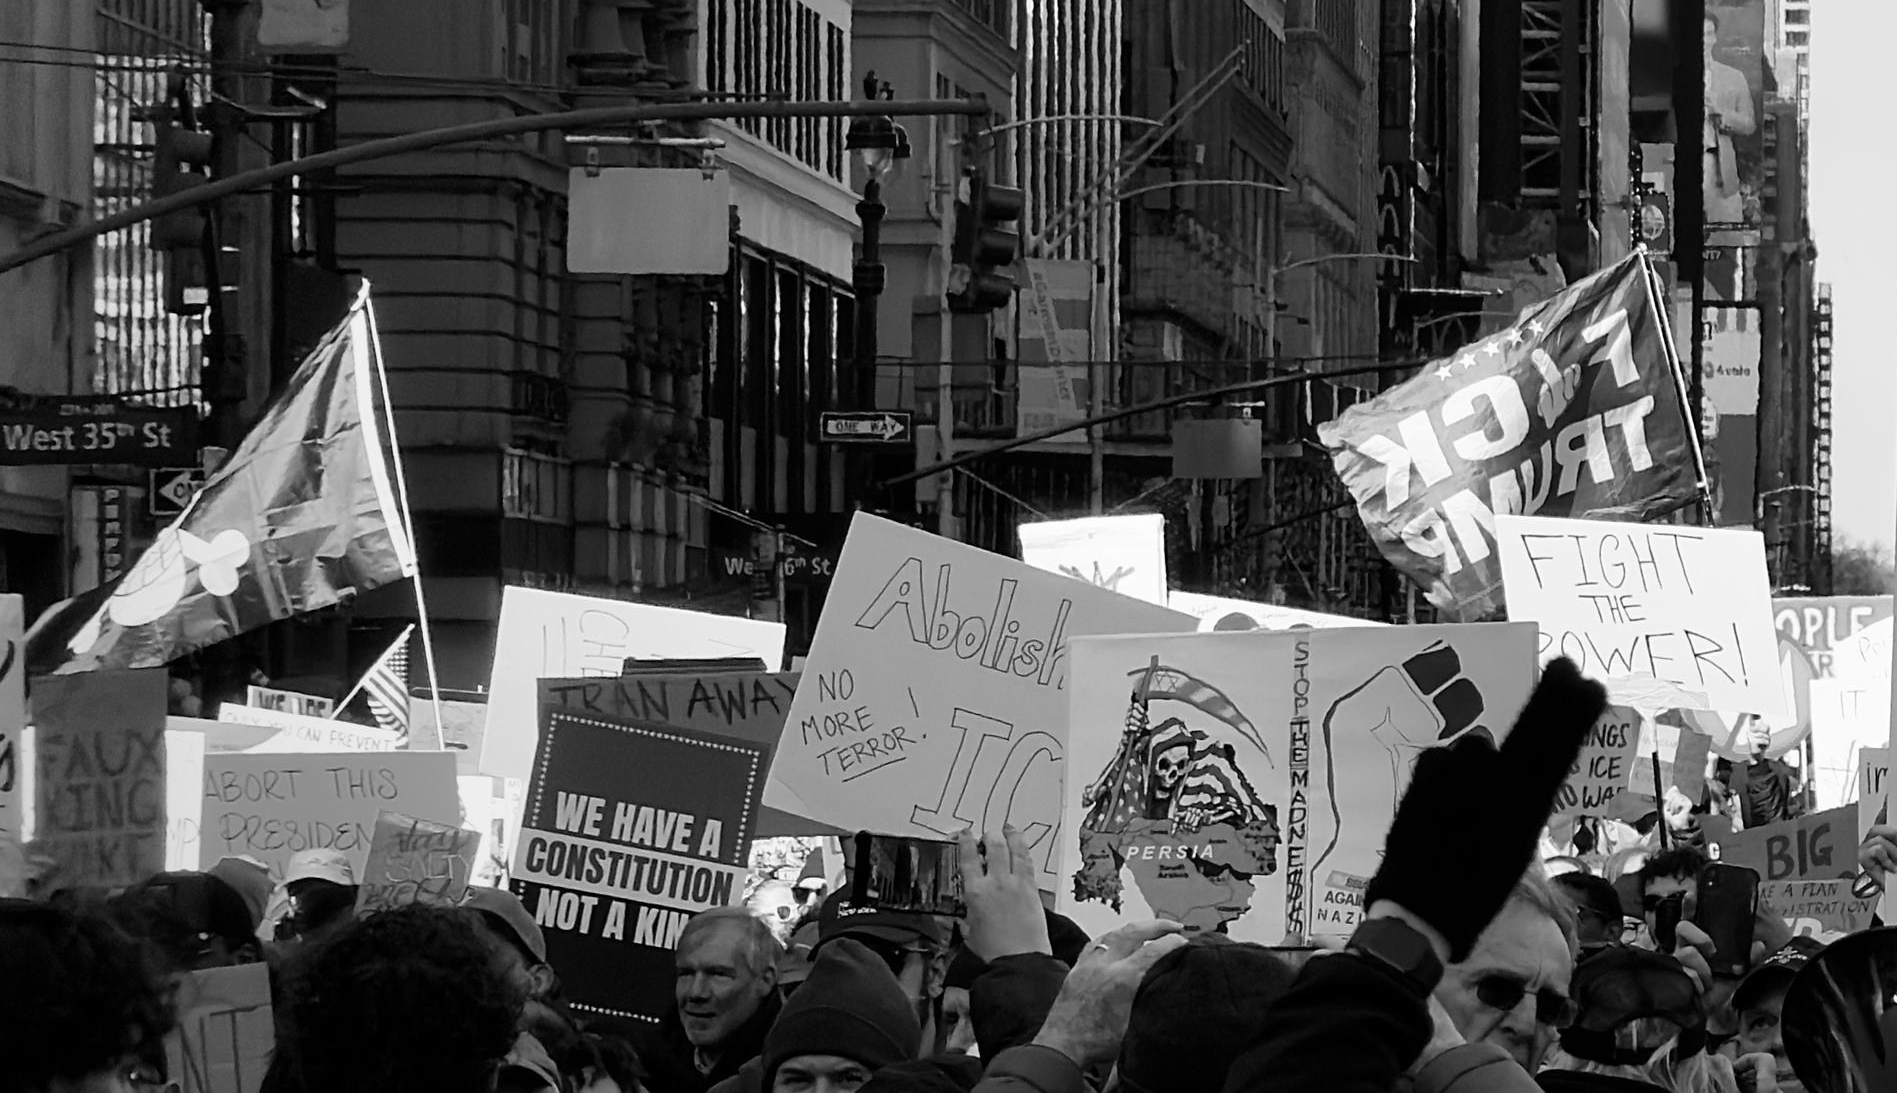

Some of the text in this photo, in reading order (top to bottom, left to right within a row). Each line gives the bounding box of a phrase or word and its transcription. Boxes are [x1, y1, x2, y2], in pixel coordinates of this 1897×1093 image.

[3, 422, 172, 450] West 35th St
[836, 420, 897, 433] ONE WAY
[812, 558, 831, 576] St
[1520, 532, 1704, 594] FIGHT
[855, 557, 1064, 690] Abolish
[1578, 595, 1647, 624] THE
[819, 669, 854, 703] NO
[1293, 641, 1311, 715] STOP
[801, 706, 874, 746] MORE
[1290, 719, 1311, 765] THE
[1584, 723, 1631, 749] NGS
[205, 768, 399, 805] ABORT THIS
[1588, 756, 1622, 780] ICE
[555, 791, 606, 837] WE
[611, 801, 695, 854] HAVE
[699, 819, 723, 859] A
[1126, 845, 1214, 860] PERSIA
[1764, 822, 1835, 880] BIG
[526, 837, 735, 907] CONSTITUTION
[536, 888, 599, 934] NOT
[602, 901, 626, 941] A
